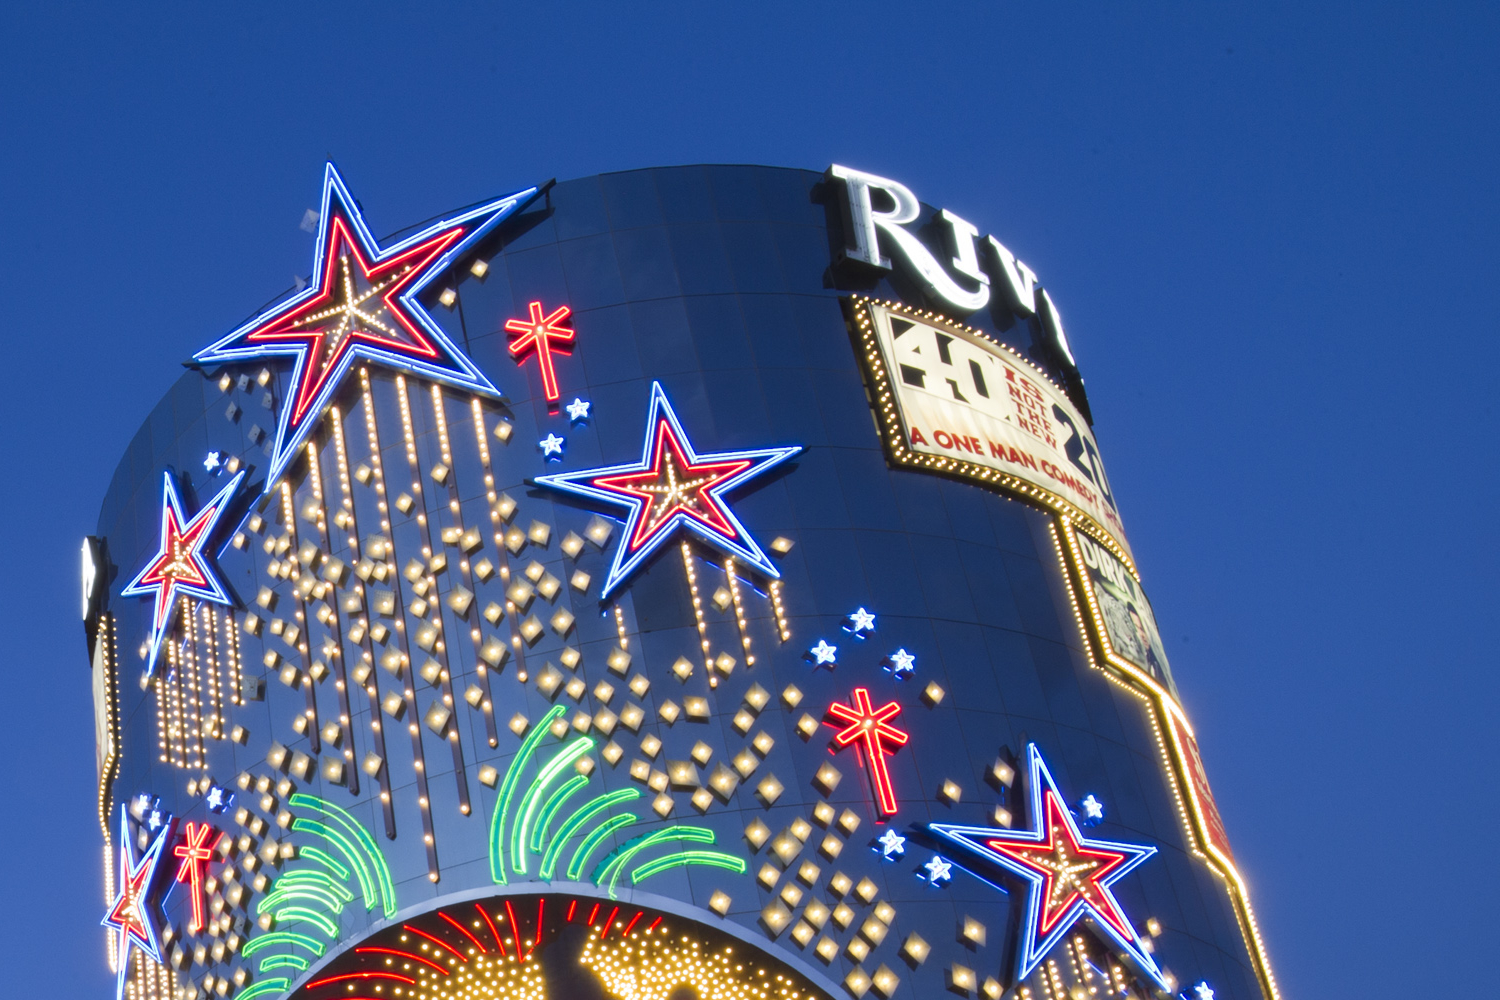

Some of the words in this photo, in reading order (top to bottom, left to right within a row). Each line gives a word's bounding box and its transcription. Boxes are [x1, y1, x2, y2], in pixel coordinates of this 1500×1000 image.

[889, 316, 1004, 421] 40
[1002, 364, 1045, 403] IS
[1006, 381, 1048, 417] NOT
[1011, 398, 1056, 436] THE
[1017, 413, 1057, 450] NEW
[910, 426, 929, 447] A
[933, 430, 984, 456] ONE
[989, 440, 1038, 472] MAN
[1041, 459, 1100, 510] COMEDY
